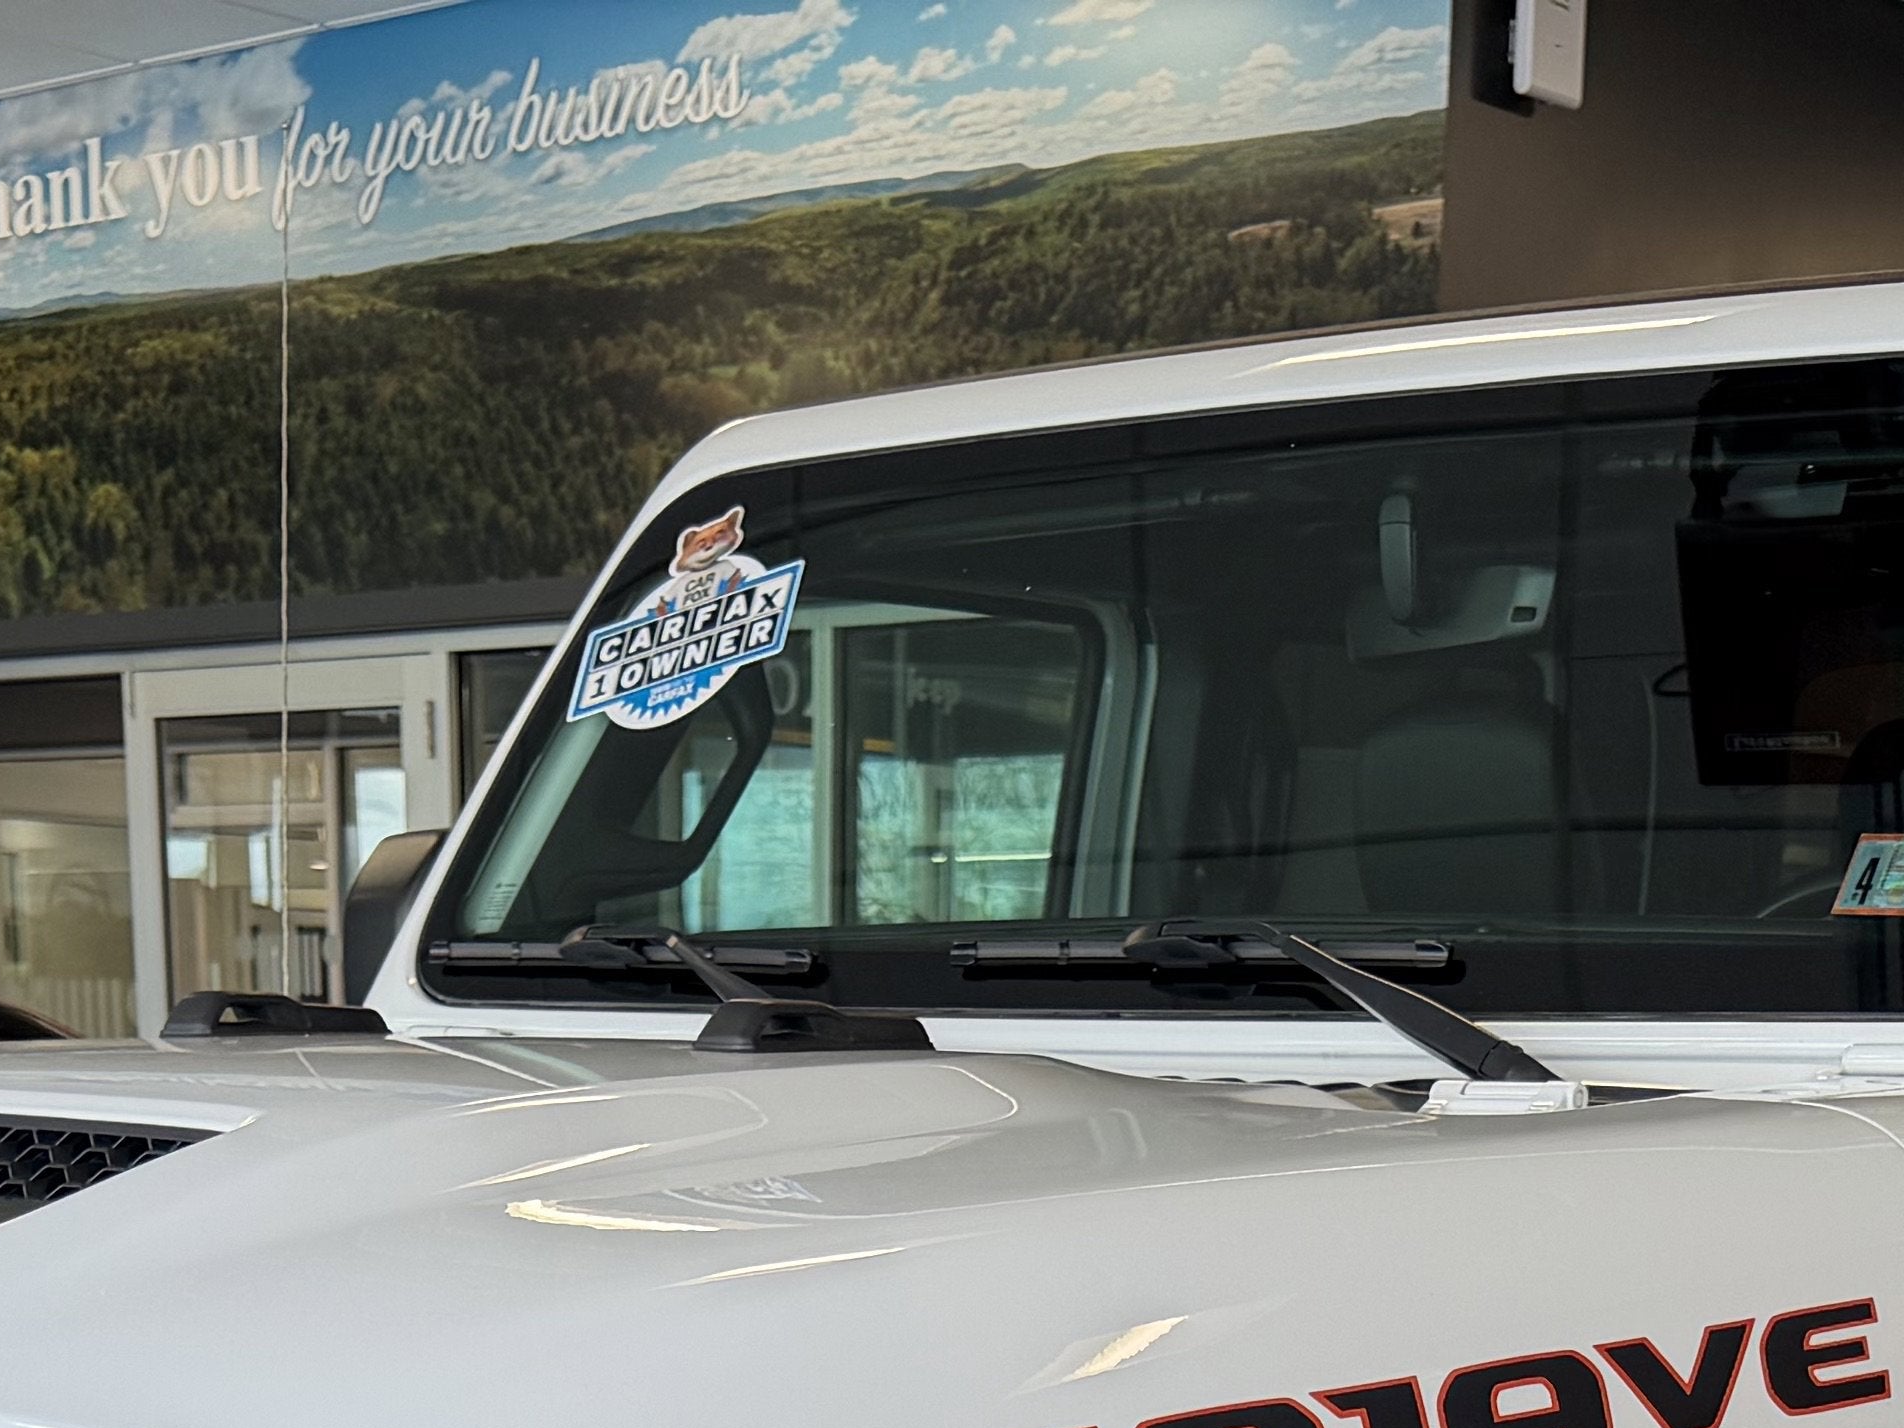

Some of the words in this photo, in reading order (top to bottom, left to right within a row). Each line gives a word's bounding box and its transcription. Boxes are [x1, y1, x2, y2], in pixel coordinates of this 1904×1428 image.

[143, 132, 260, 239] you
[271, 106, 358, 230] for
[362, 97, 501, 225] your
[503, 52, 752, 152] business
[683, 587, 711, 606] FOX
[685, 572, 716, 593] CAR
[599, 587, 783, 664] CARFAX
[1855, 857, 1881, 905] 4
